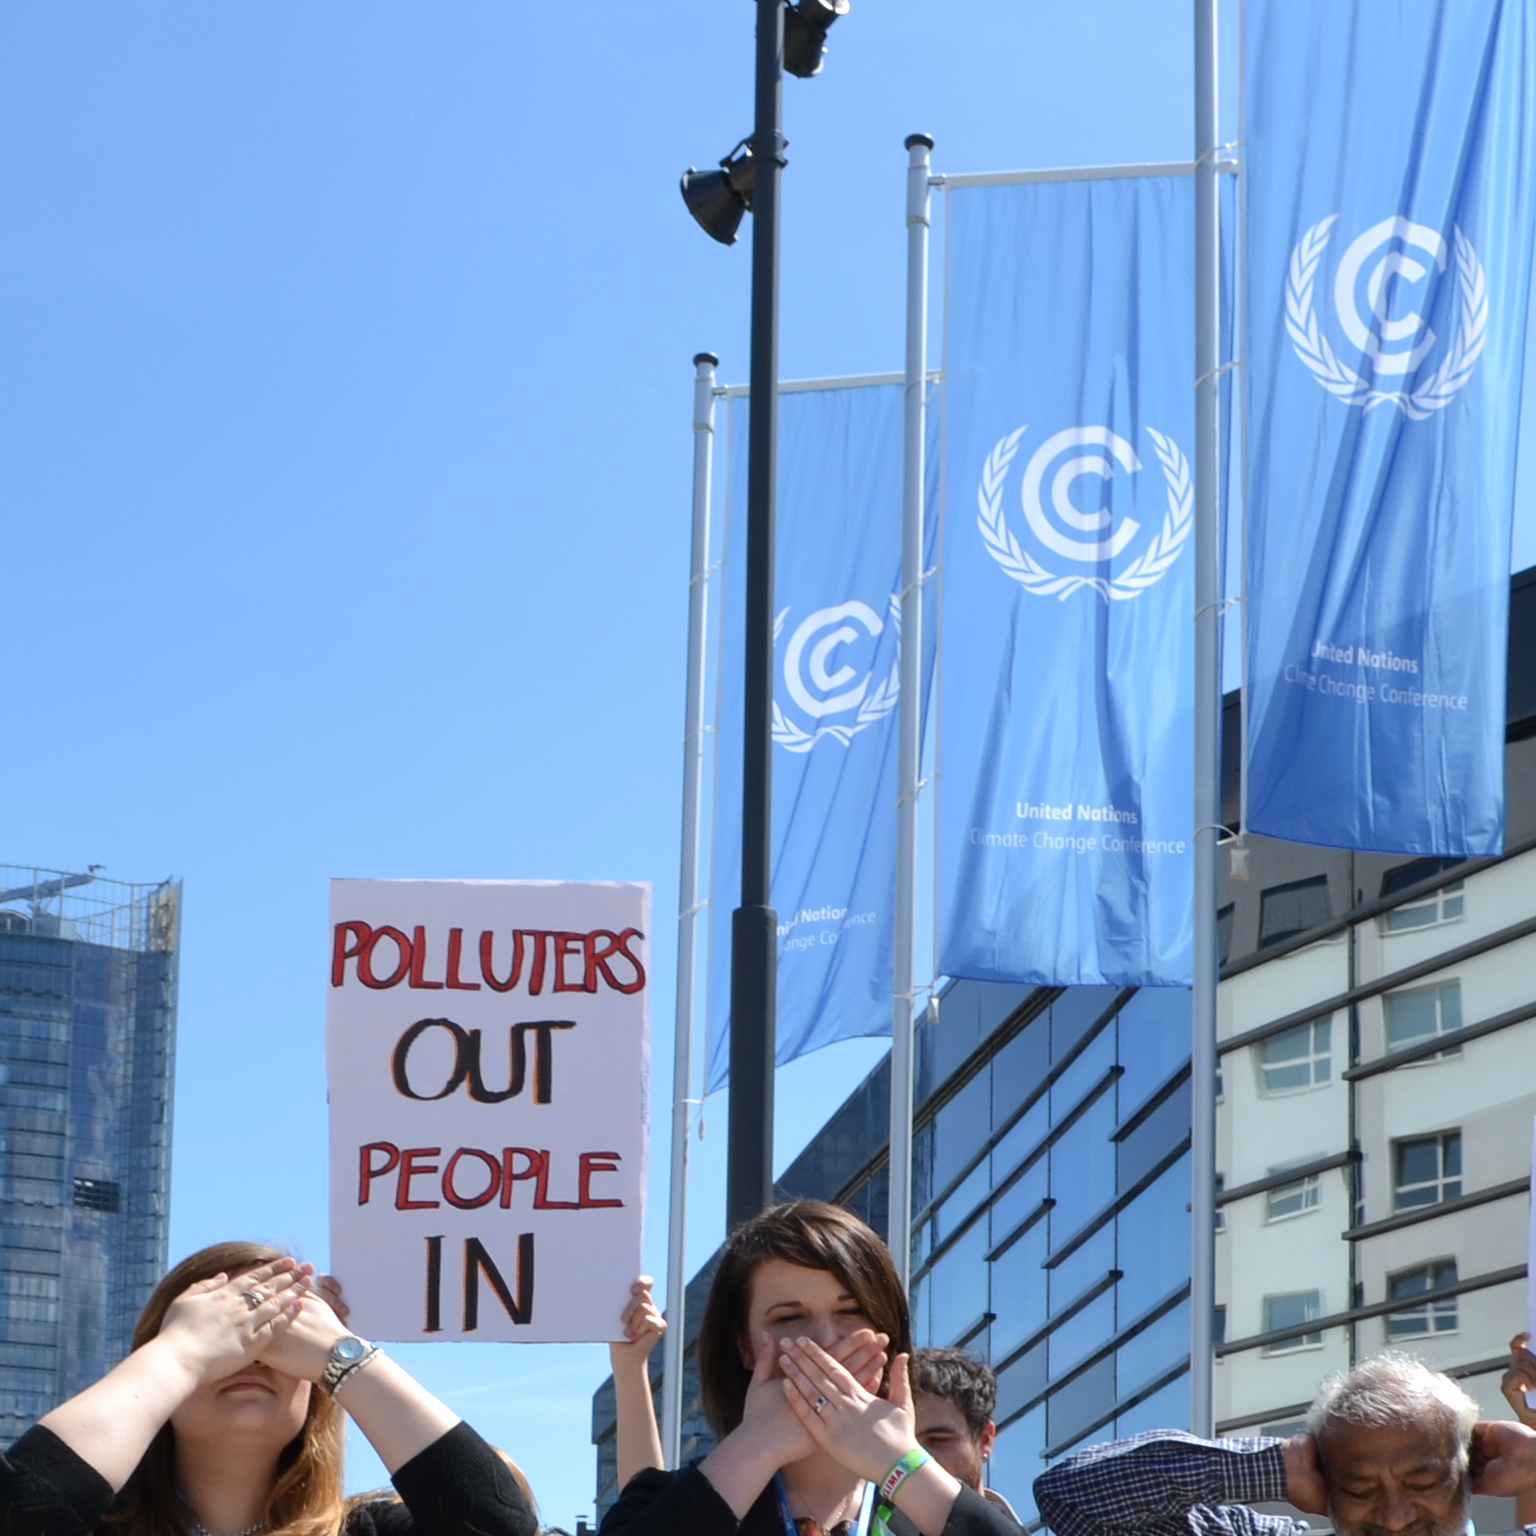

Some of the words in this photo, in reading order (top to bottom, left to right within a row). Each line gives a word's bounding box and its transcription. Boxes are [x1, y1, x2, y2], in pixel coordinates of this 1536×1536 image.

[1357, 647, 1419, 674] Nations
[1318, 674, 1376, 704] Change
[1379, 683, 1468, 710] Conference
[1016, 802, 1073, 820] United
[1076, 803, 1138, 824] Nations
[970, 828, 1028, 848] Climate
[1032, 831, 1097, 854] Change
[1101, 834, 1186, 854] Conference
[332, 920, 646, 996] POLLUTERS
[392, 1017, 576, 1105] OUT
[358, 1141, 627, 1210] PEOPLE
[423, 1232, 535, 1333] IN
